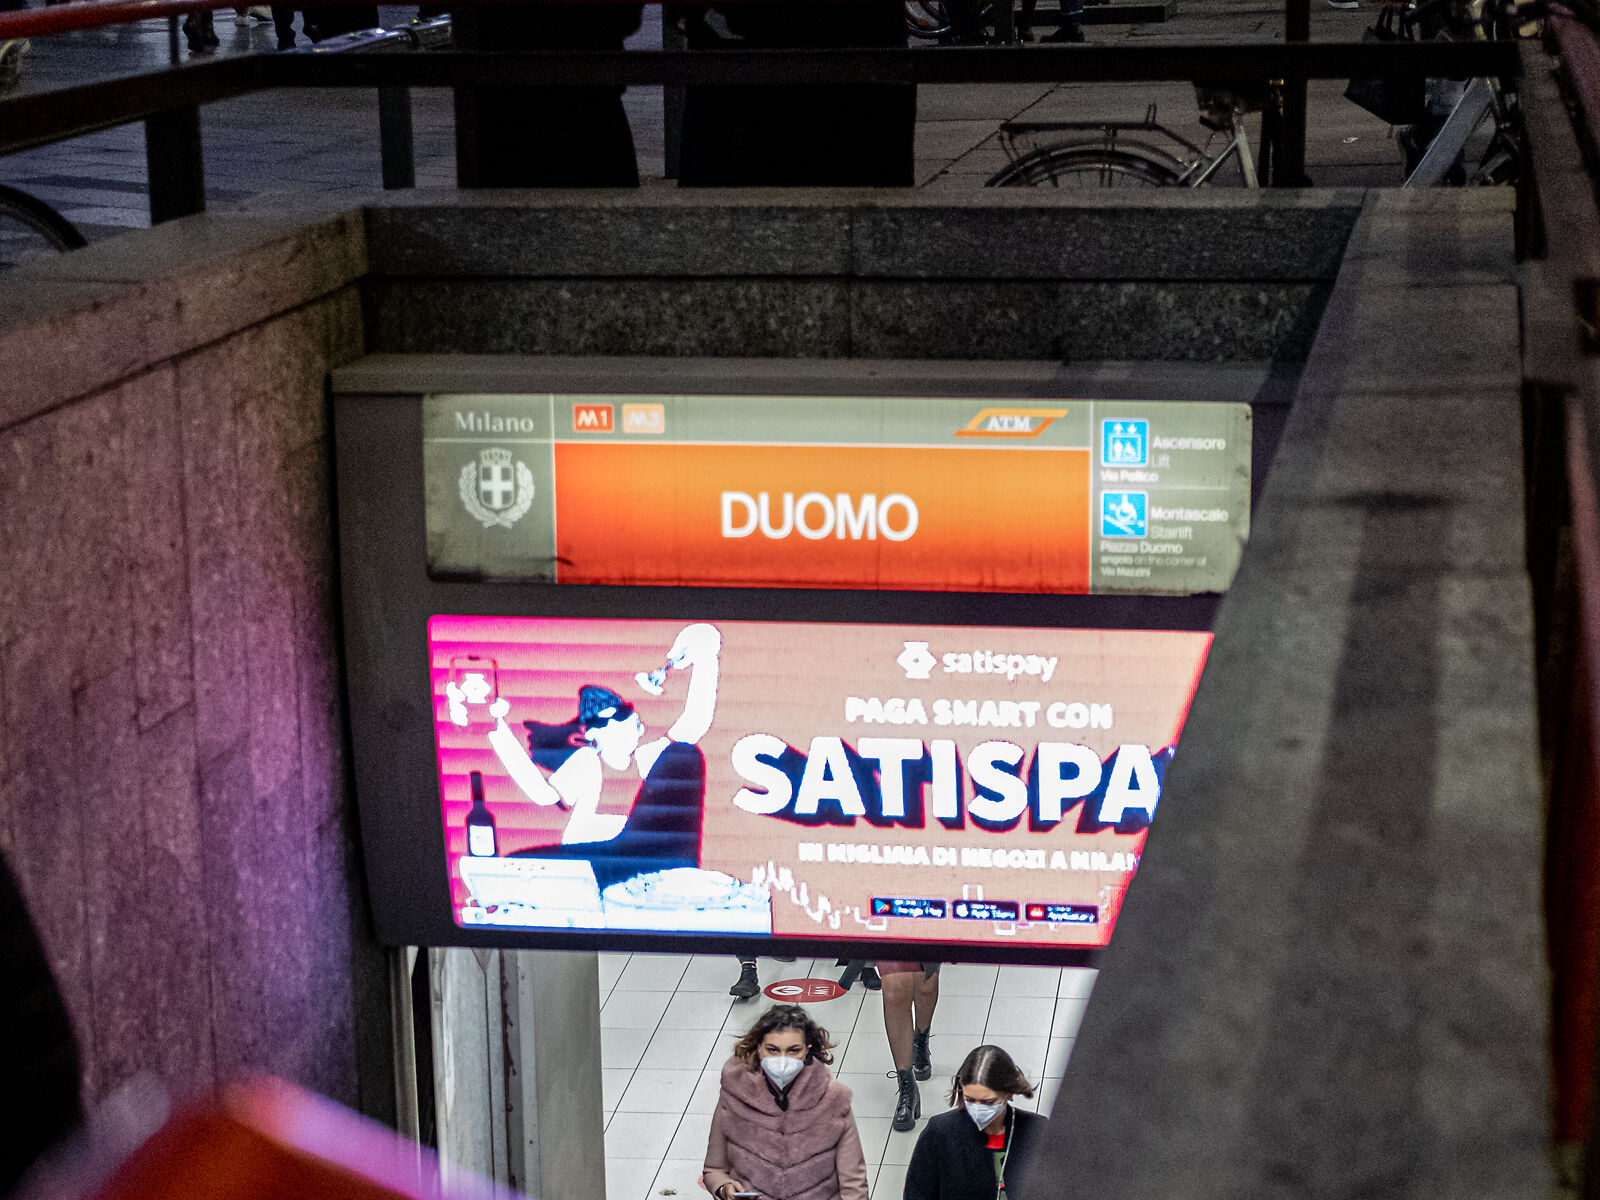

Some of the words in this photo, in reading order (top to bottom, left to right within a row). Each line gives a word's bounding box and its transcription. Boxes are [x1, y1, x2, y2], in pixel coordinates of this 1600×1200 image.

[455, 411, 534, 433] Milano
[578, 410, 609, 428] M1
[628, 411, 661, 428] M3
[985, 415, 1033, 432] ATM
[1153, 436, 1226, 450] Ascensore
[1152, 455, 1170, 468] Lift
[1101, 471, 1119, 482] Via
[721, 491, 919, 542] DUOMO
[1151, 507, 1229, 522] Montascale
[1150, 526, 1193, 540] Stairlift
[1100, 541, 1138, 553] Piazza
[1140, 542, 1183, 555] Duomo
[942, 650, 1058, 682] satispay
[845, 696, 929, 726] PAGA
[932, 699, 1041, 727] SMART
[1046, 703, 1113, 729] CON
[730, 733, 1176, 826] SATISPA
[933, 847, 957, 866] DI
[961, 848, 1045, 869] NEGOZI
[1050, 850, 1068, 869] A
